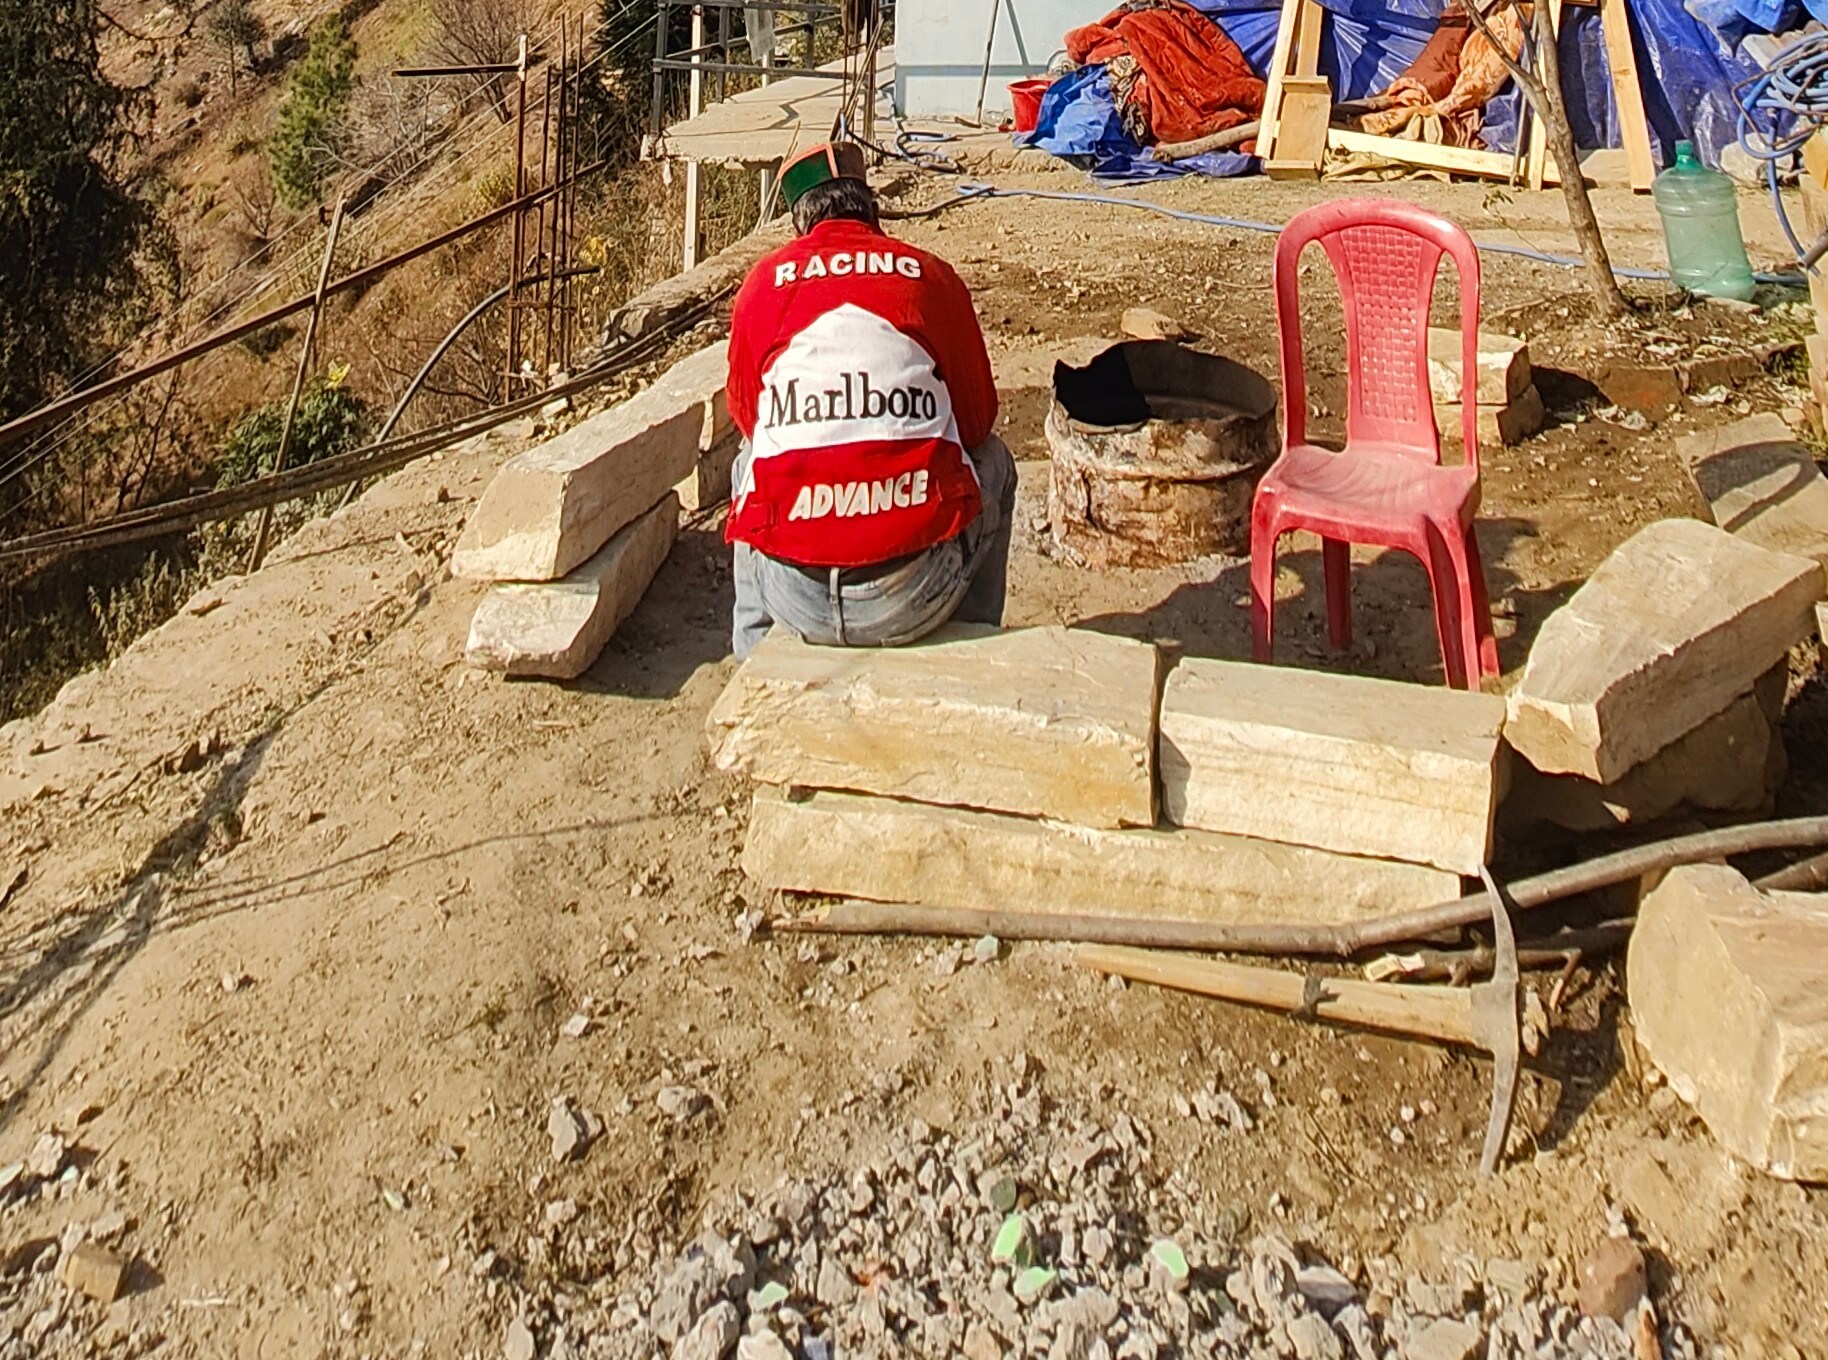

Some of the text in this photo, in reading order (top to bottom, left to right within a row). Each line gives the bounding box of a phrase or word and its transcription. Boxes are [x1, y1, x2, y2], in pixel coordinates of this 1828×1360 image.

[774, 252, 921, 288] RACING
[764, 372, 937, 429] Marlboro
[788, 470, 929, 522] ADVANCE
